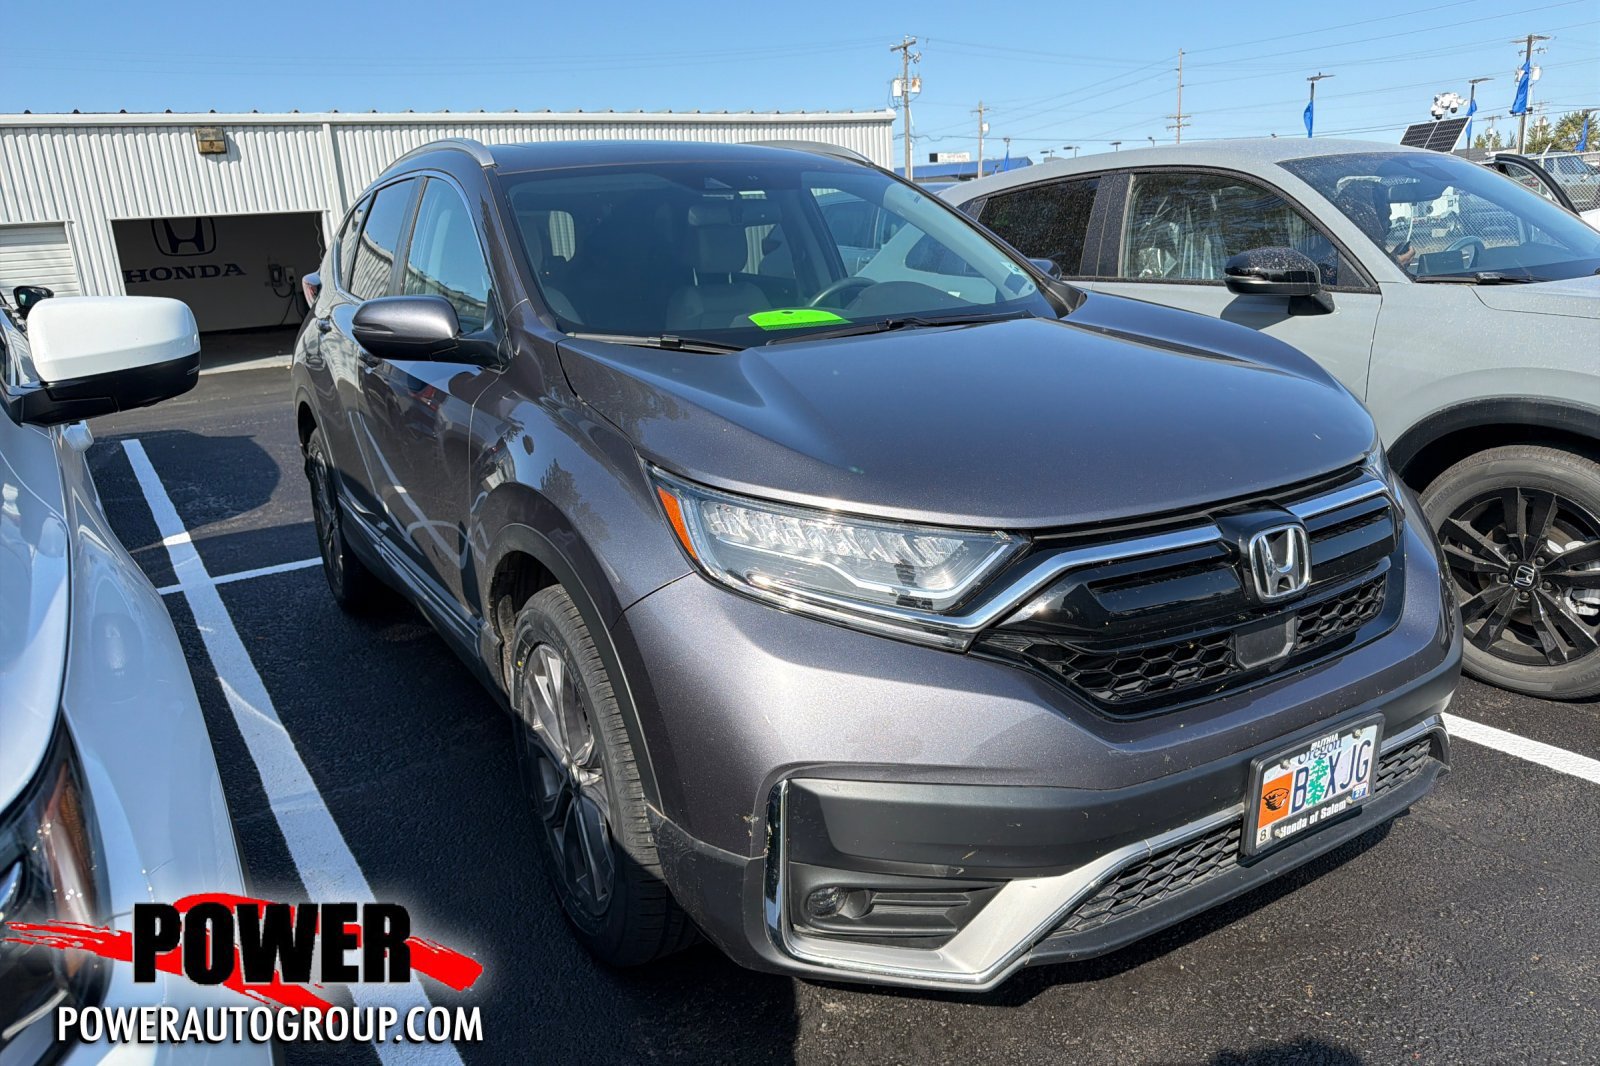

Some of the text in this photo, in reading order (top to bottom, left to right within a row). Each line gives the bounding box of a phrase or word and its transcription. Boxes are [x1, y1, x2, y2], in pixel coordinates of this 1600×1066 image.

[122, 263, 247, 283] HONDA
[1297, 739, 1343, 765] Oregon
[1280, 799, 1347, 838] Honda of Salem
